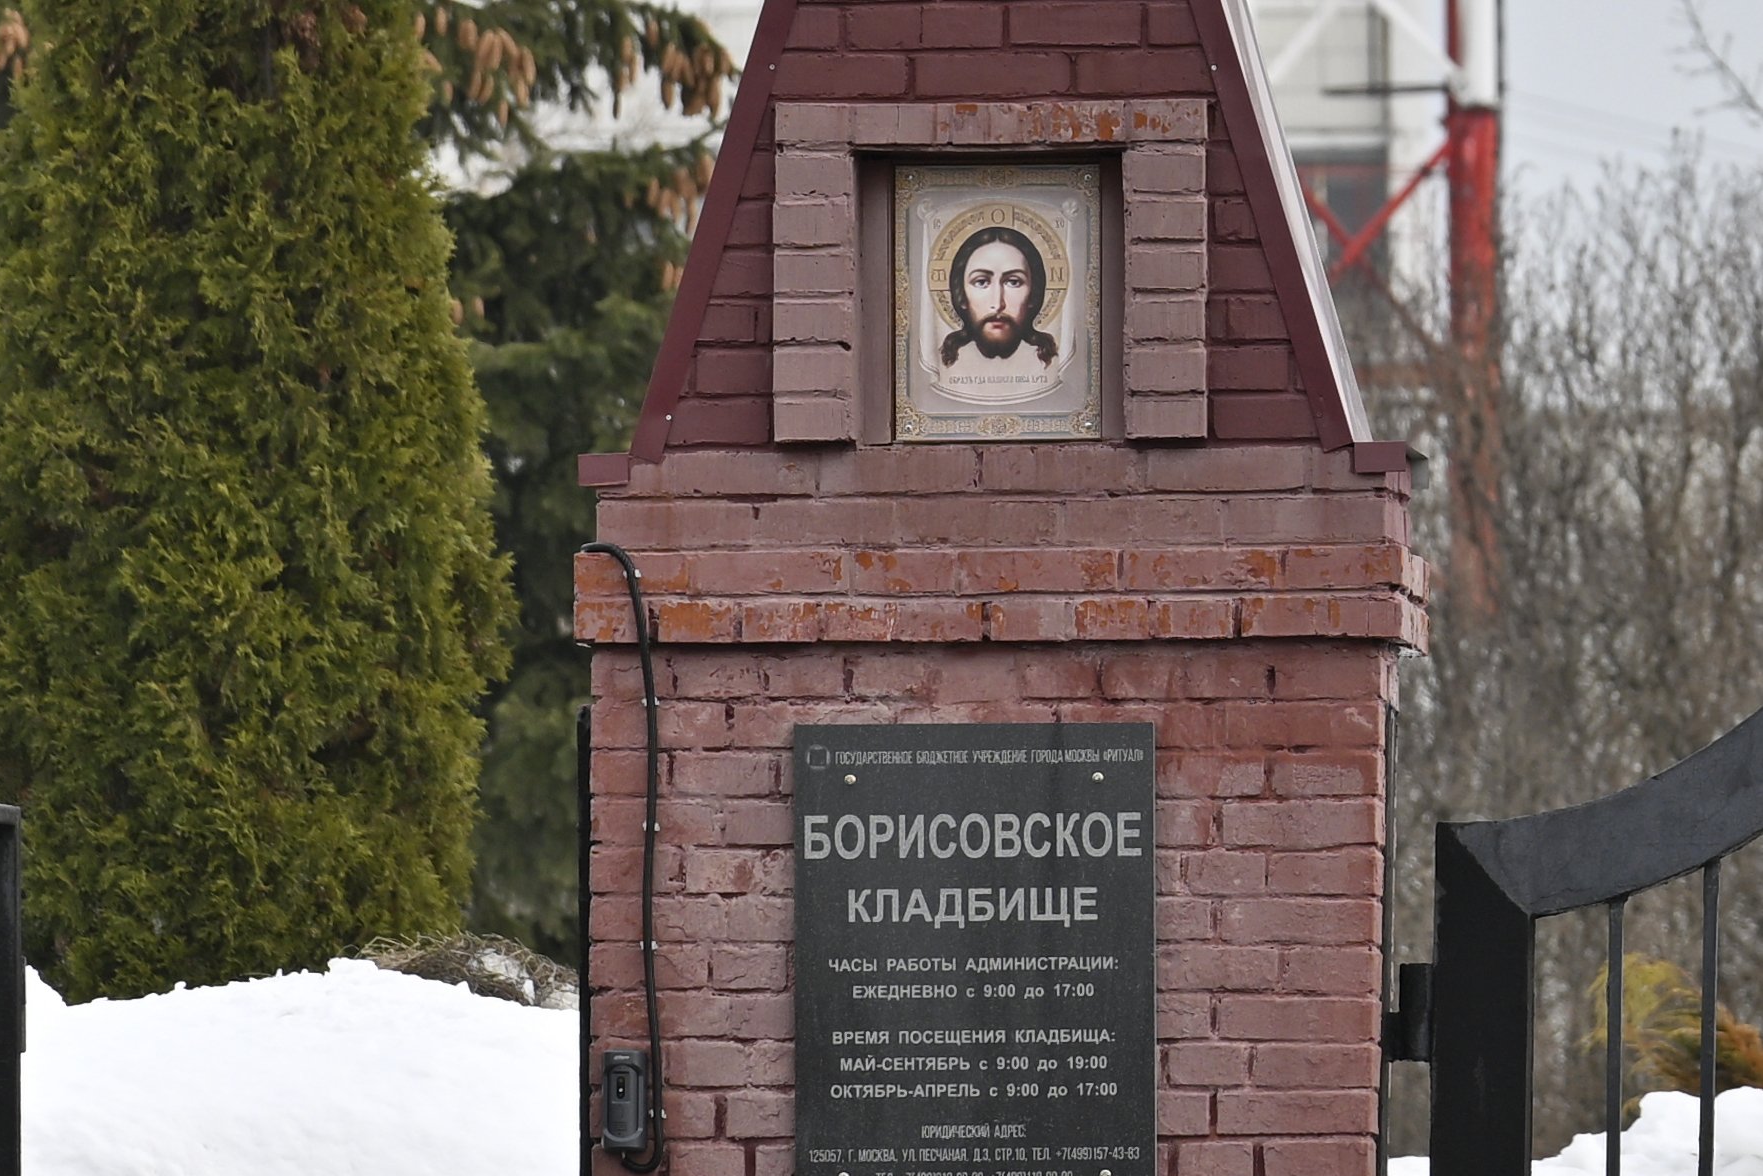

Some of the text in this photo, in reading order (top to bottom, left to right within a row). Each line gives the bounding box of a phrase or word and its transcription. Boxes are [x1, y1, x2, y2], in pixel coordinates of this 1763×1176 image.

[835, 749, 1144, 766] ГОСУДАРСТВЕННОЕ БЮДЖЕТНОЕ УЧРЕЖДЕНИЕ ГОРОДА МОСКВЫ «РИТУАЛ»
[803, 812, 1142, 860] БОРИСОВСКОЕ
[847, 887, 1099, 930] КЛАДБИЩЕ
[828, 956, 1119, 973] ЧАСЫ РАБОТЫ АДМИНИСТРАЦИИ:
[852, 985, 958, 1001] ЕЖЕДНЕВНО
[983, 984, 1016, 998] 9:00
[1024, 987, 1045, 1000] до
[1054, 983, 1095, 998] 17:00
[832, 1028, 1116, 1047] ВРЕМЯ ПОСЕЩЕНИЯ КЛАДБИЩА:
[840, 1055, 971, 1071] МАЙ-СЕНТЯБРЬ
[997, 1056, 1029, 1070] 9:00
[1037, 1060, 1058, 1072] до
[1067, 1055, 1108, 1070] 19:00
[830, 1083, 981, 1099] ОКТЯБРЬ-АПРЕЛЬ
[1007, 1083, 1039, 1097] 9:00
[1047, 1086, 1068, 1099] до
[1077, 1082, 1118, 1097] 17:00
[921, 1123, 1027, 1140] ЮРИДИЧЕСКИЙ АДРЕС:
